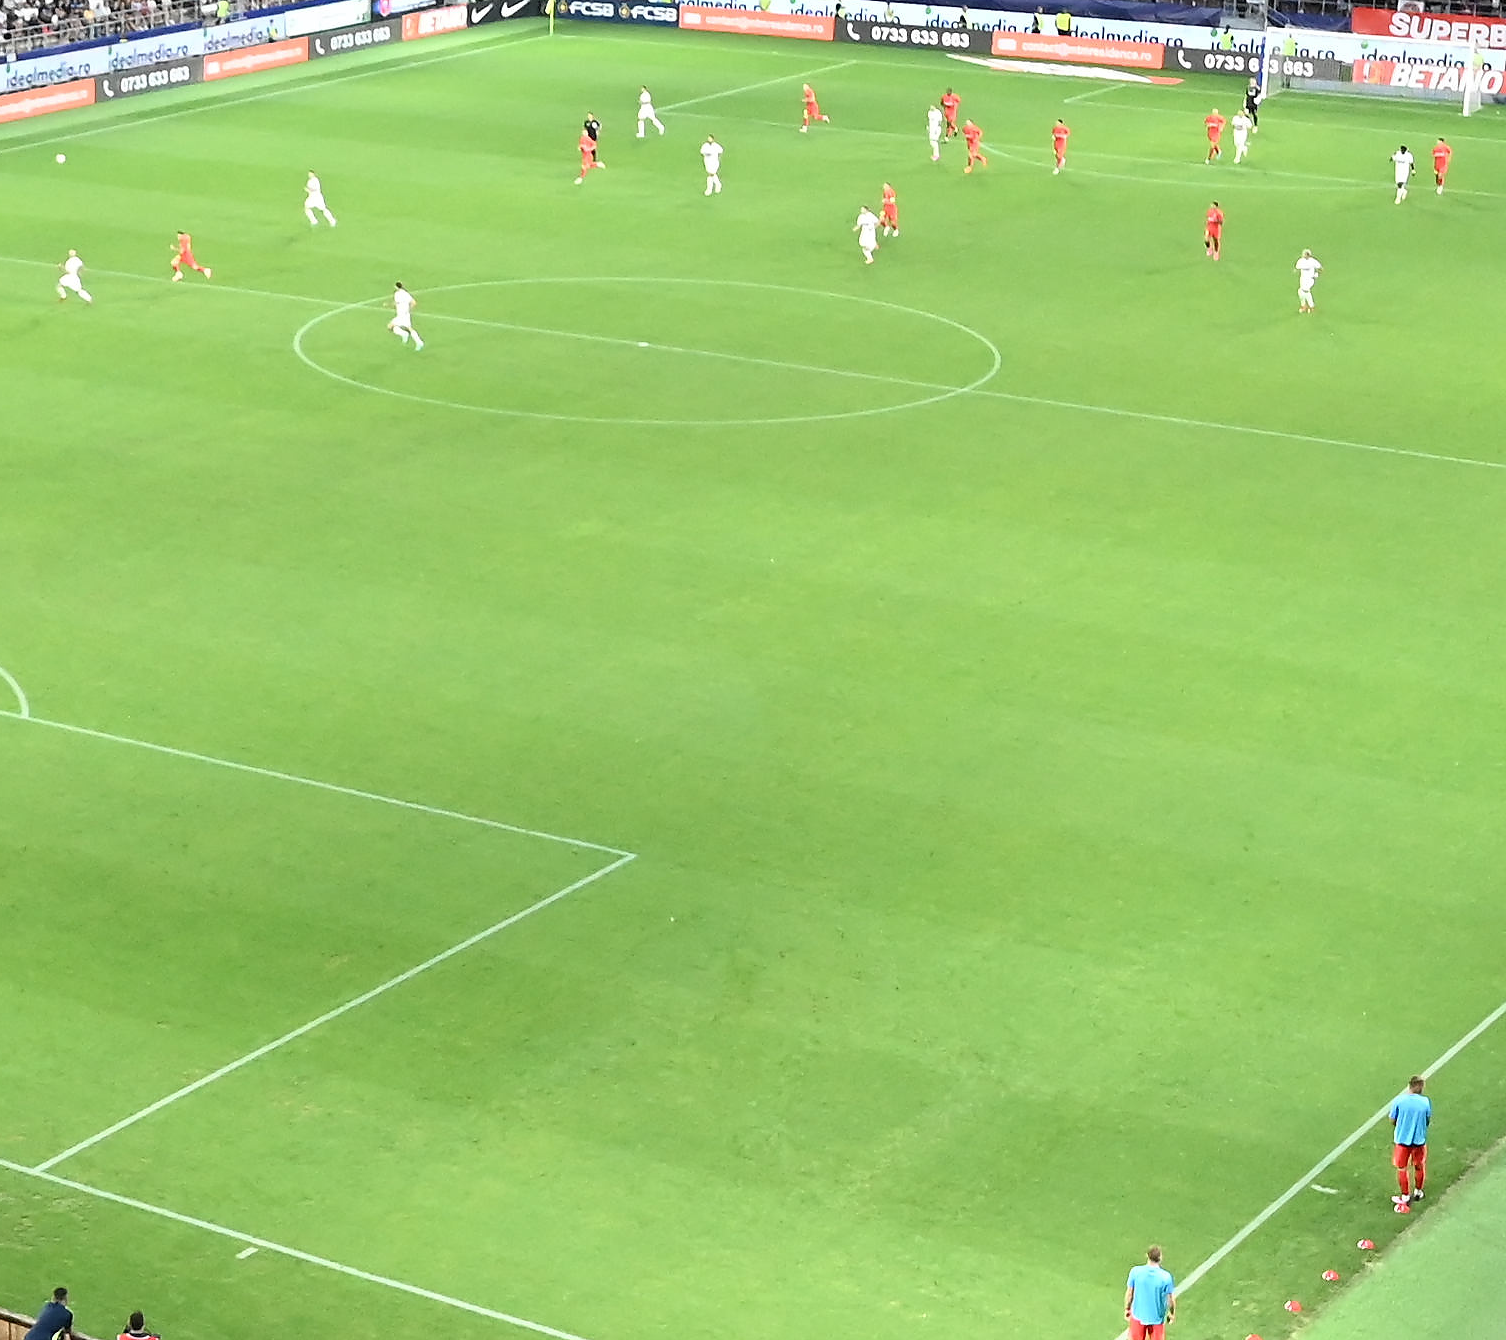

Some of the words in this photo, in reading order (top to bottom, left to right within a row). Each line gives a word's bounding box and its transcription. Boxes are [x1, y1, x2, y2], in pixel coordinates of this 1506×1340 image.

[569, 1, 615, 18] FCSB
[631, 4, 678, 22] FCSB
[871, 25, 907, 44] 0733
[1204, 53, 1245, 71] 0733
[1249, 56, 1278, 73] 63
